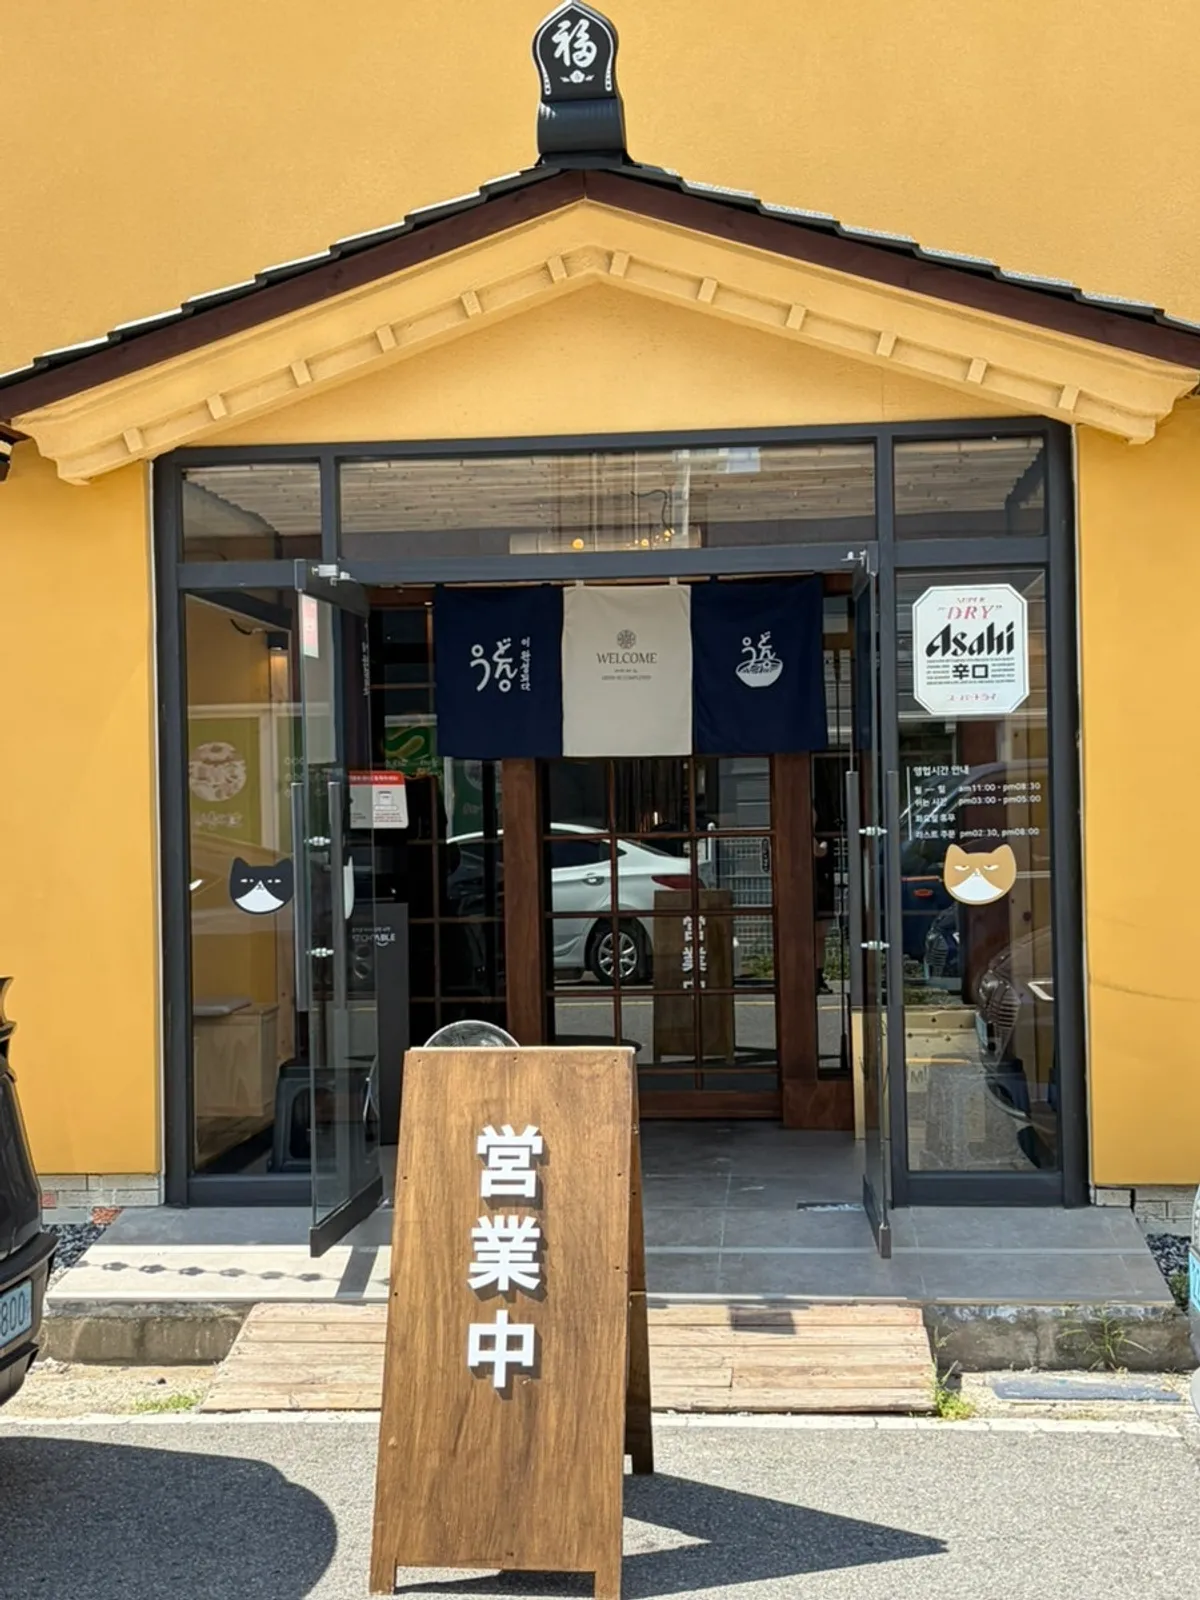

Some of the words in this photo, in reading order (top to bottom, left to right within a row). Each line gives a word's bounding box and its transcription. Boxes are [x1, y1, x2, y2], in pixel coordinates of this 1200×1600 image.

[551, 19, 597, 68] 福
[596, 652, 658, 664] WELCOME
[925, 621, 1014, 657] Asahi
[952, 663, 988, 680] 辛口
[467, 1124, 543, 1388] 営業中
[0, 1291, 25, 1337] 800
